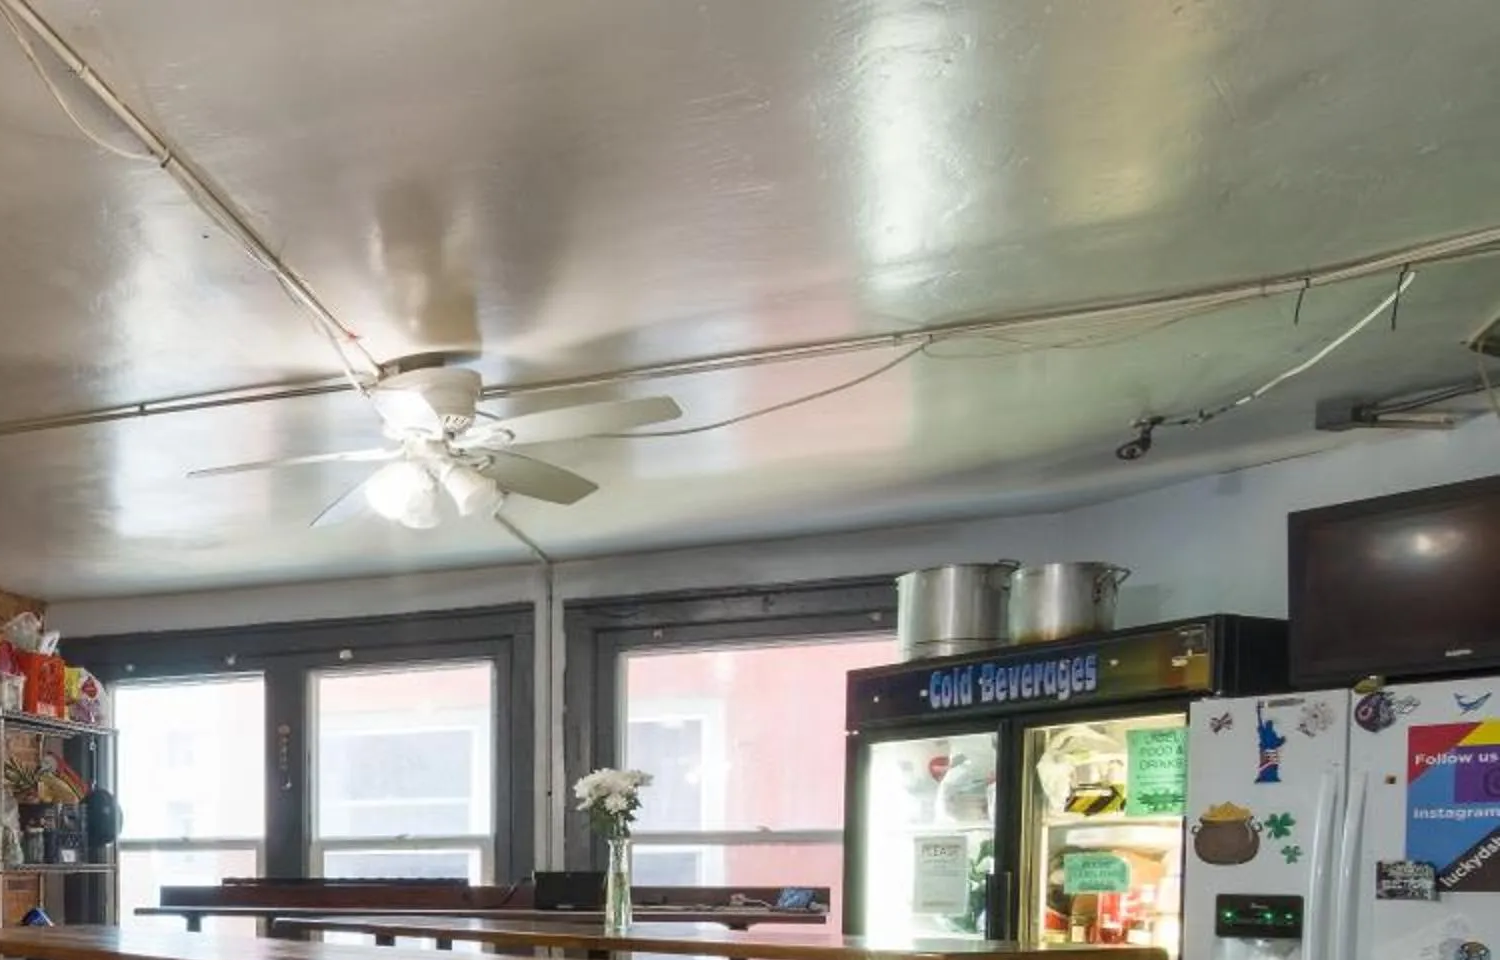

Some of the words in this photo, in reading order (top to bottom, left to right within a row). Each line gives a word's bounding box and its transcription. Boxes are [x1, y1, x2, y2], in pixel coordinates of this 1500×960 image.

[929, 665, 973, 710] Cold
[979, 652, 1097, 702] Beverages
[1415, 751, 1473, 766] Follow
[1478, 751, 1500, 764] us
